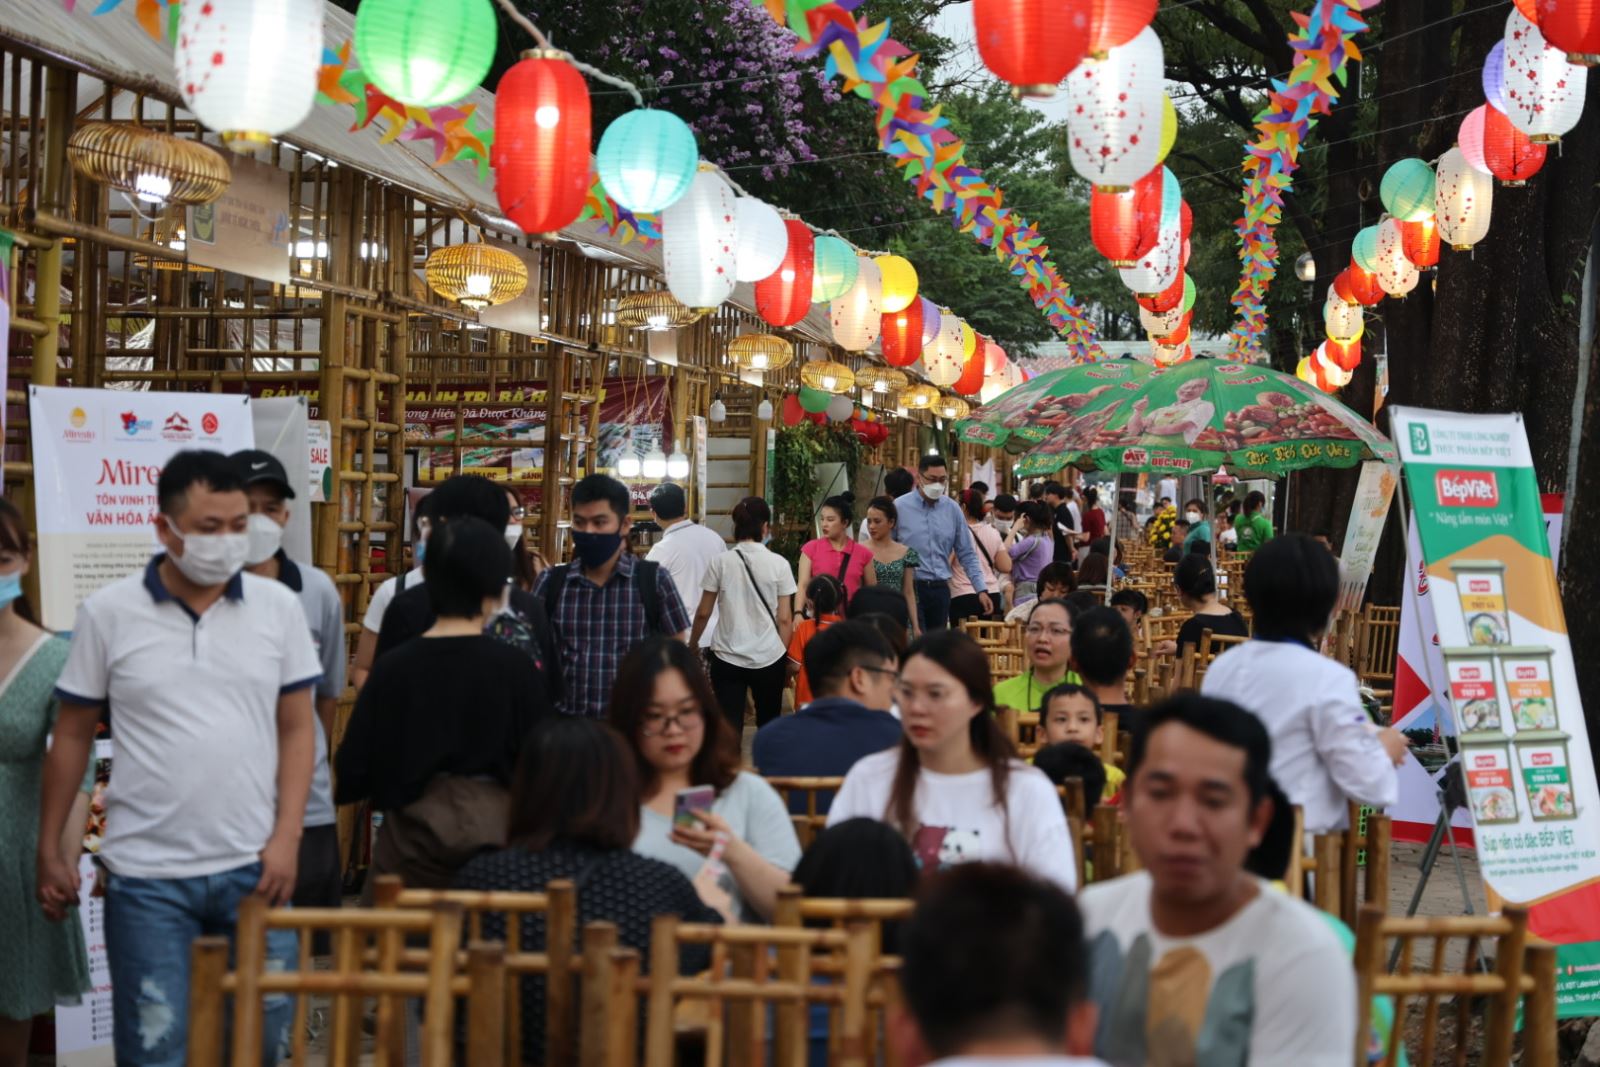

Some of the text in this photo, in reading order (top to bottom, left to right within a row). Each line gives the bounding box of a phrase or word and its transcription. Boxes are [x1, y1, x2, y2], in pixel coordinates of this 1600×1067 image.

[310, 448, 328, 463] SALE
[96, 493, 116, 505] TÔN
[119, 495, 144, 505] VINH
[87, 510, 112, 525] VĂN
[116, 509, 143, 525] HÓA
